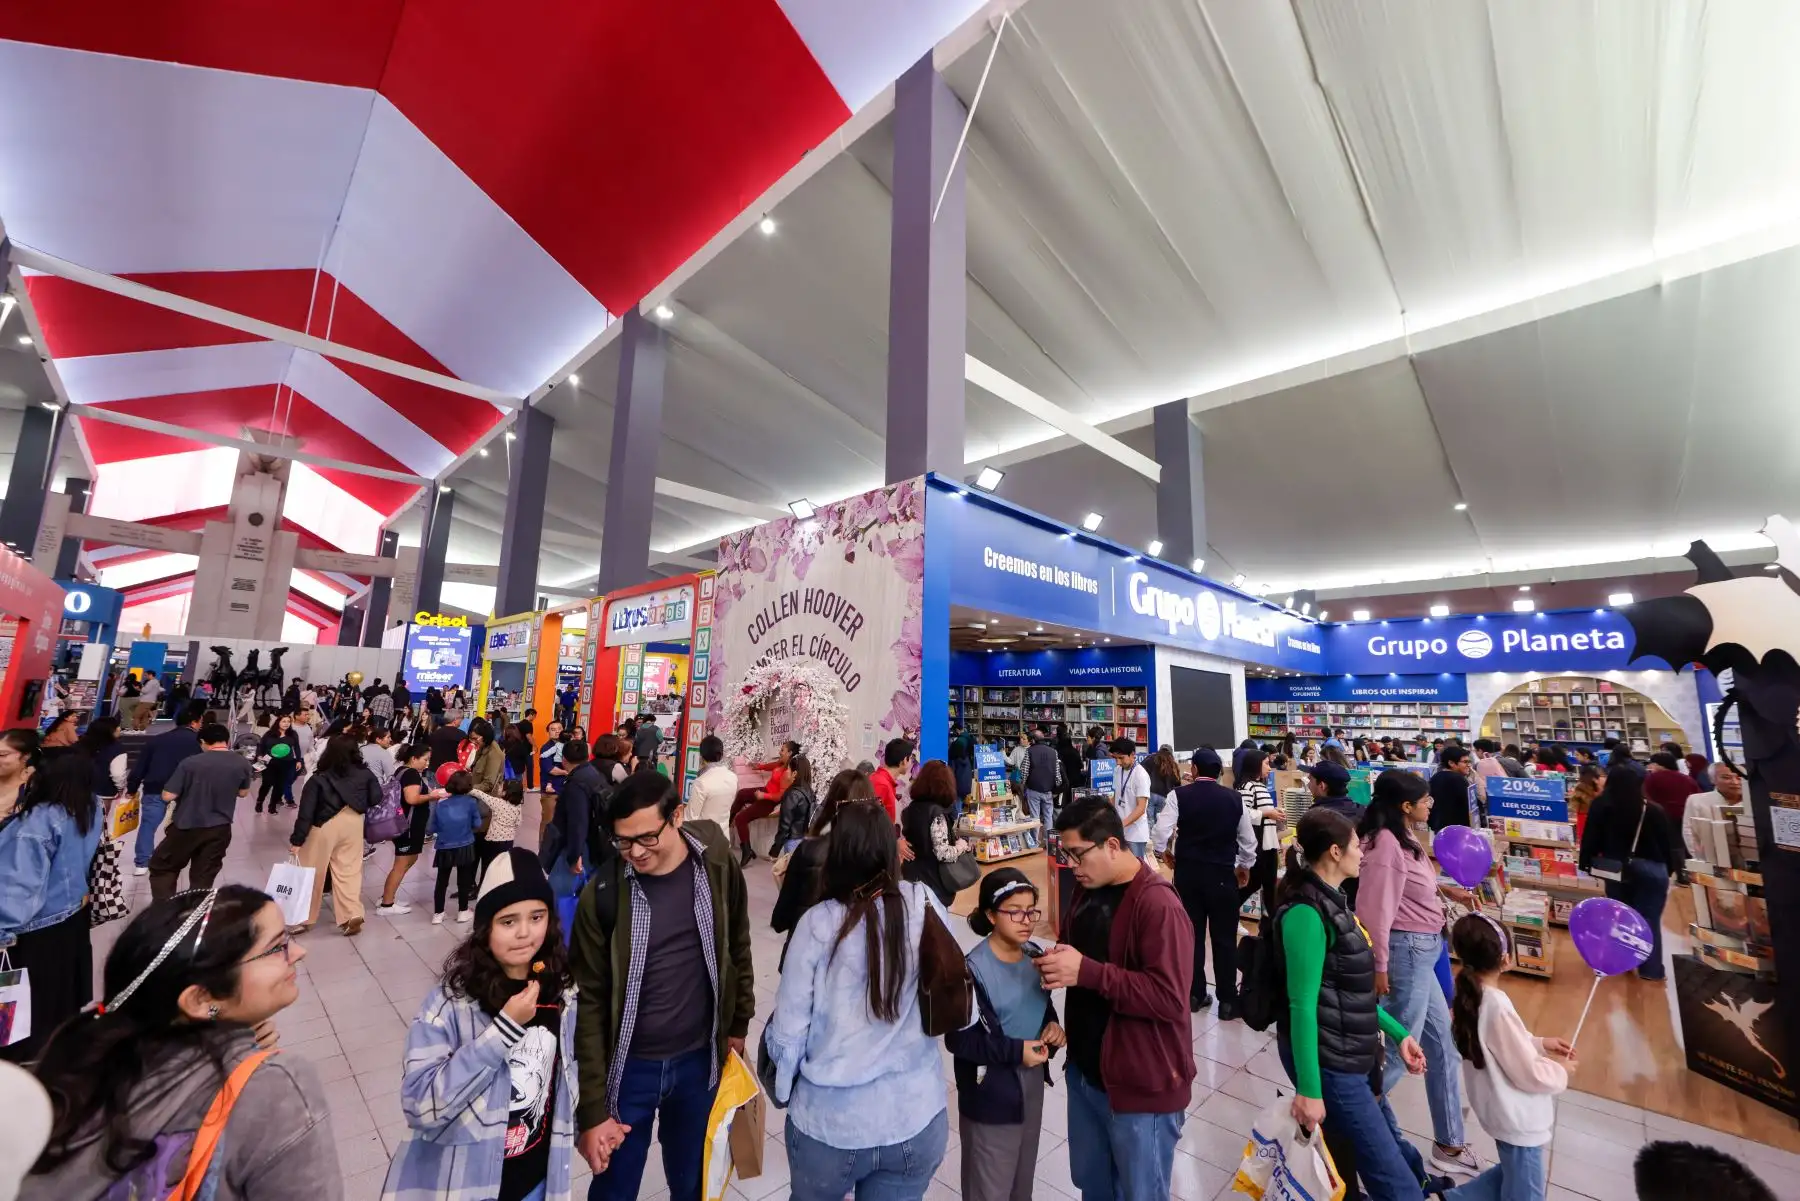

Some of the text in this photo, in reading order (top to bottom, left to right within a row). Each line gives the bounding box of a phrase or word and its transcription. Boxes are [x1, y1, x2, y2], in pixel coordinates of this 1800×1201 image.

[983, 546, 1098, 595] Creemos en los libros
[1129, 571, 1196, 635] Grupo
[415, 611, 468, 628] Crisol
[747, 587, 864, 645] COLLEN HOOVER
[1368, 628, 1625, 660] Grupo Planeta
[756, 638, 789, 667] MPER
[809, 633, 861, 693] CÍRCULO
[999, 668, 1042, 677] LITERATURA
[1110, 665, 1142, 674] HISTORIA
[1380, 688, 1397, 696] QUE
[982, 754, 997, 763] 20%
[1096, 761, 1110, 771] 20%
[1502, 779, 1540, 792] 20%
[1502, 801, 1552, 812] LEER CUESTA
[1516, 809, 1540, 817] POCO
